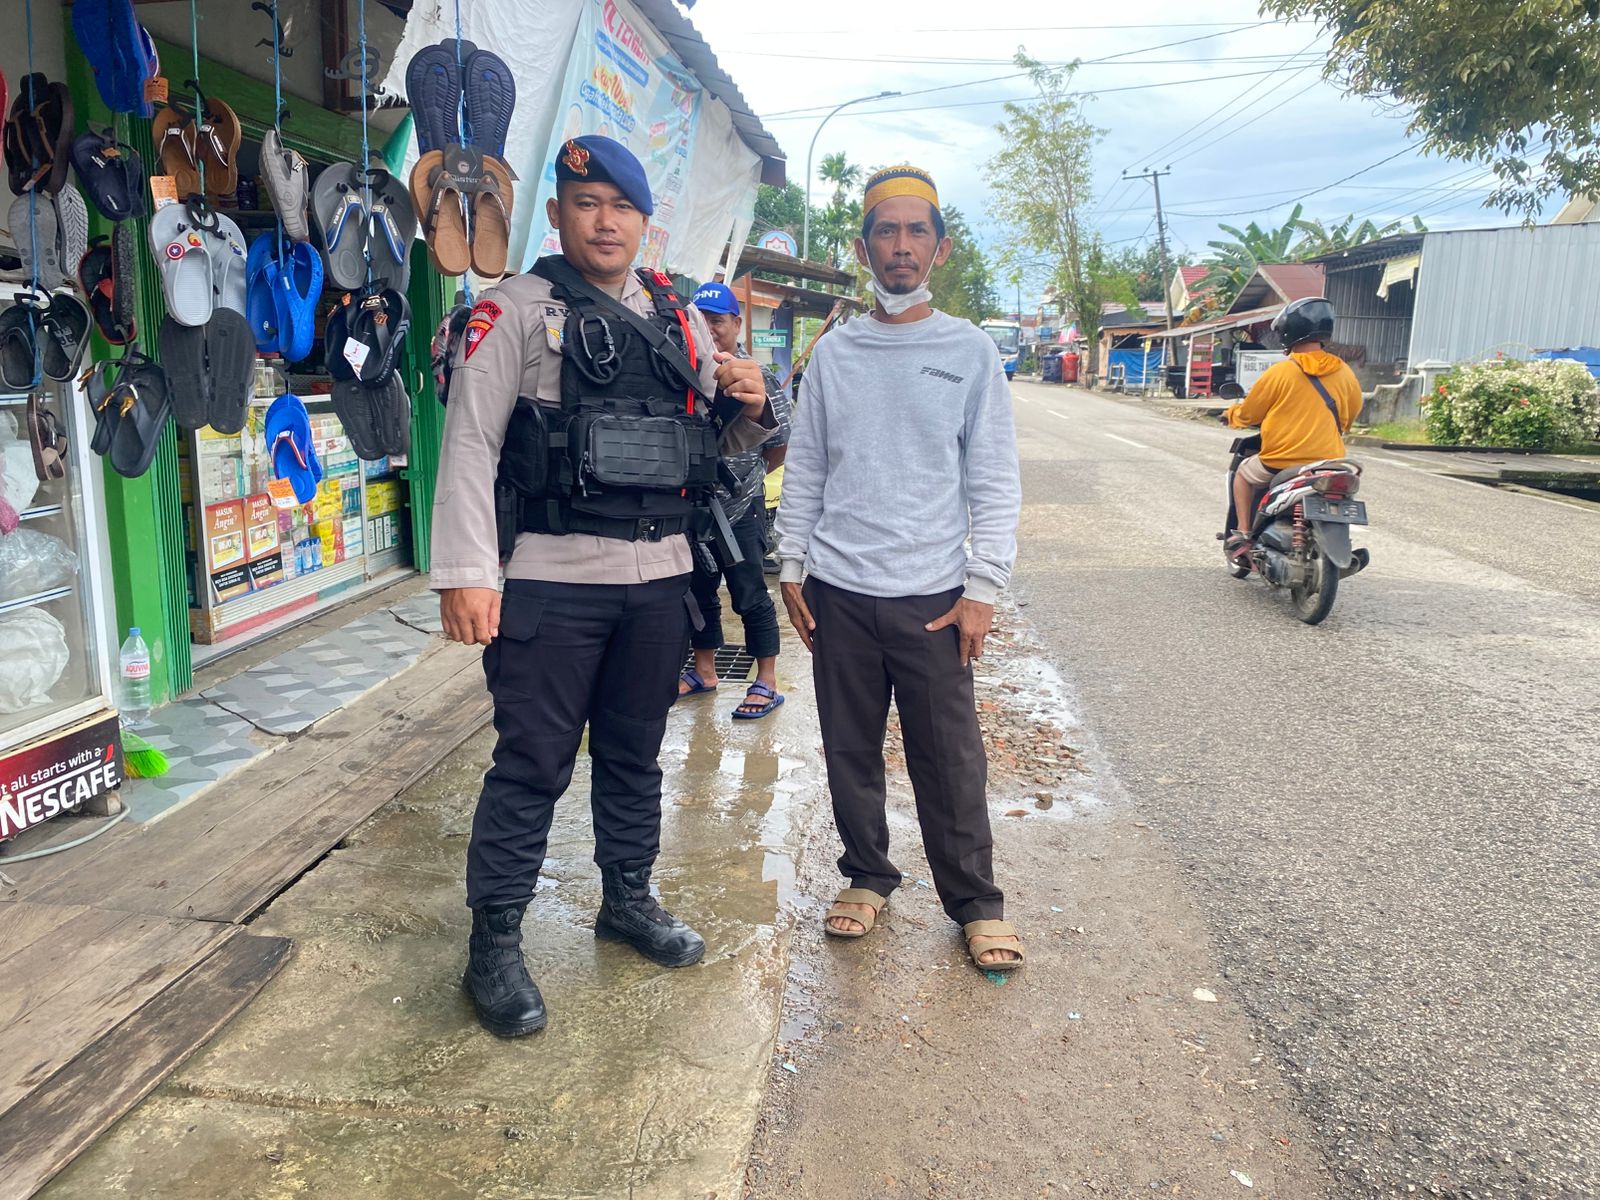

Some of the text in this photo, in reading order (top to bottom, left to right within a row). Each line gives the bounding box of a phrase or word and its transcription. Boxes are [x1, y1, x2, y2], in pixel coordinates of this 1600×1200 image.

[215, 507, 233, 517] MASUK
[10, 776, 29, 791] all
[31, 761, 67, 783] starts
[68, 750, 93, 768] with
[94, 747, 102, 757] a
